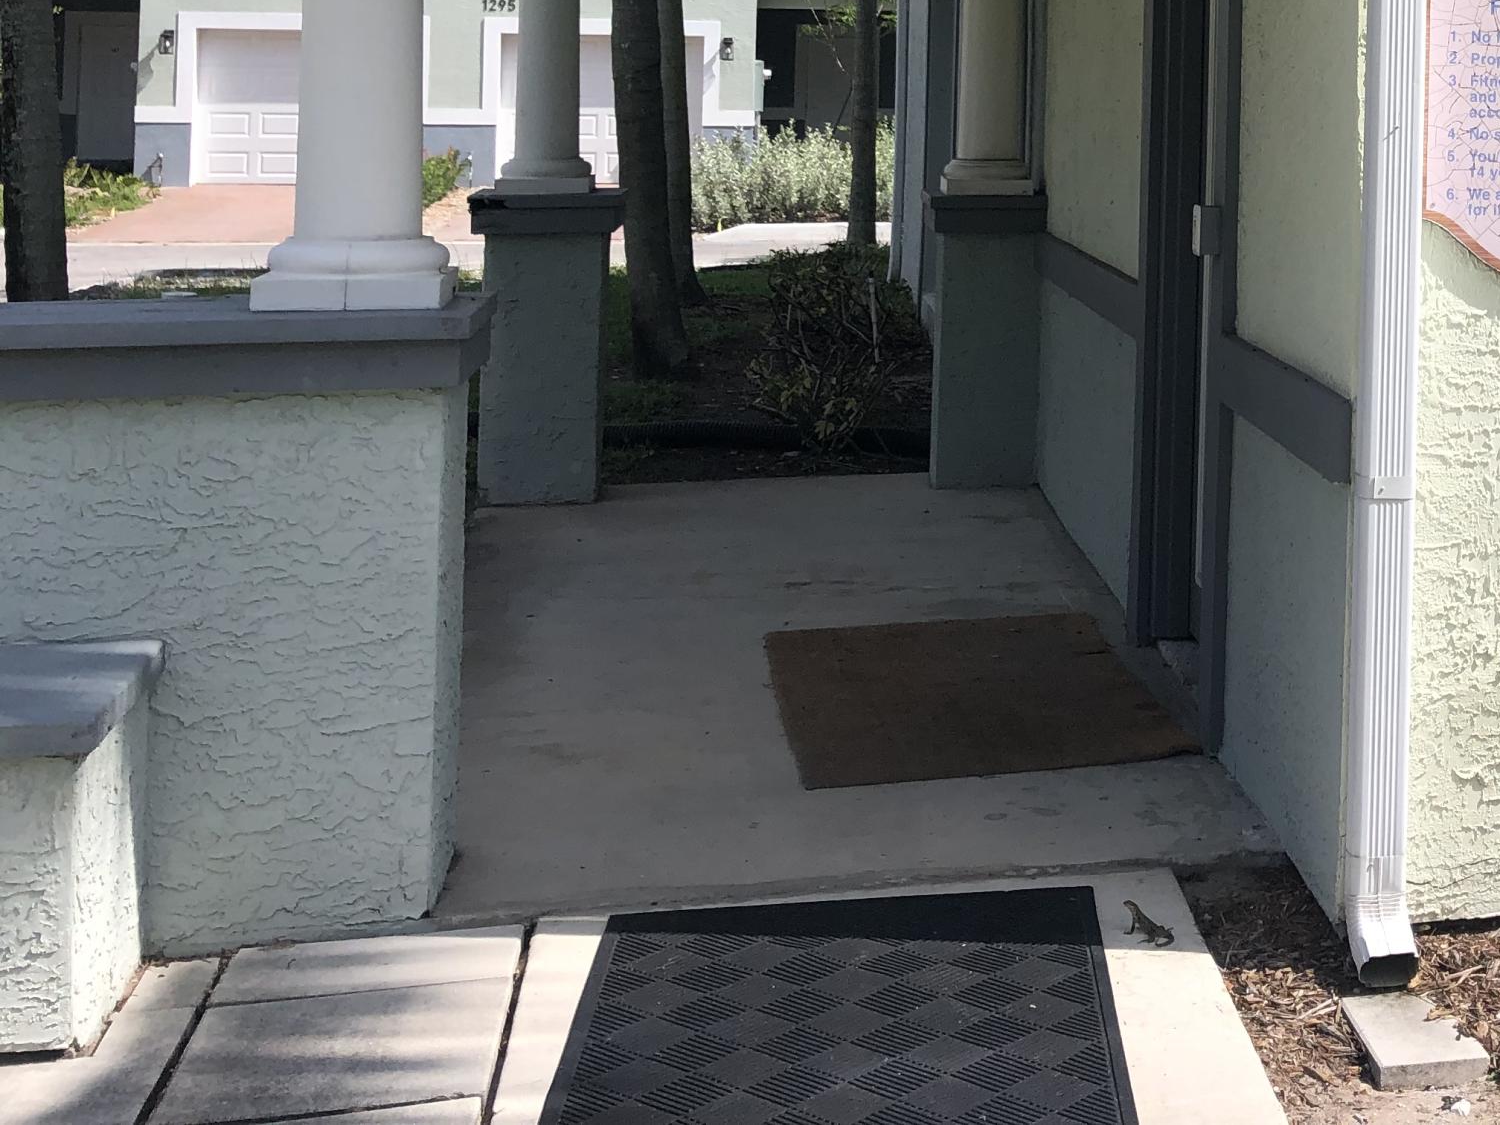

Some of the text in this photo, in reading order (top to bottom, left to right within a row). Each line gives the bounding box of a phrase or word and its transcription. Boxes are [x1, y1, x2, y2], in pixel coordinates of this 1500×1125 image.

[482, 0, 516, 12] 1295
[1450, 31, 1461, 42] 1.
[1471, 31, 1491, 43] No
[1449, 52, 1461, 64] 2.
[1449, 75, 1461, 87] 3.
[1470, 91, 1496, 103] and
[1448, 128, 1459, 139] 4.
[1469, 128, 1489, 140] No
[1447, 150, 1459, 162] 5.
[1470, 149, 1496, 162] You
[1471, 167, 1484, 177] 14
[1446, 188, 1458, 200] 6.
[1468, 188, 1490, 200] We
[1468, 204, 1488, 216] for
